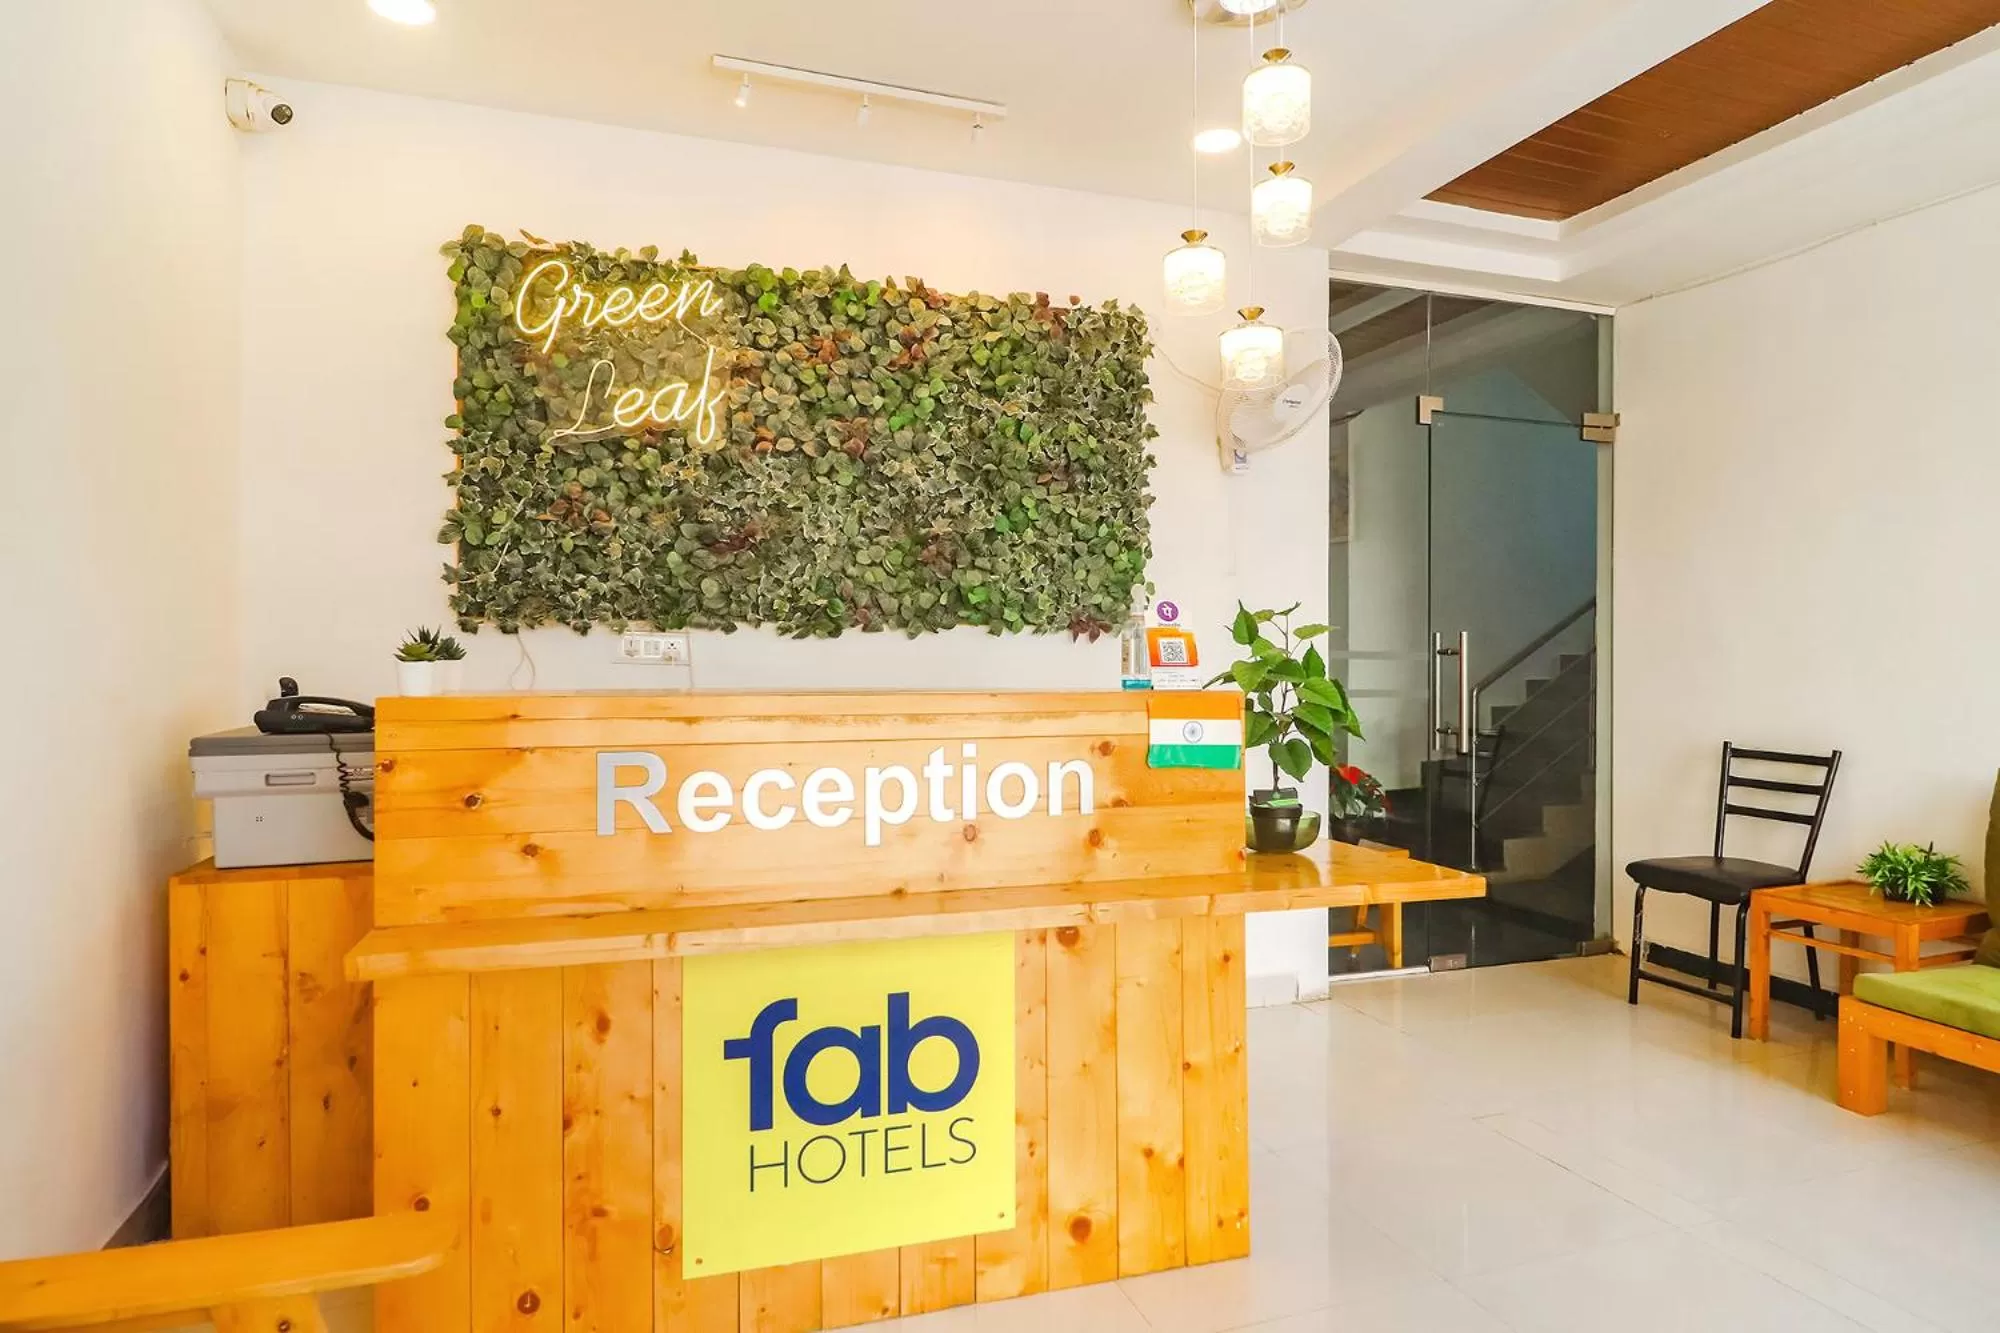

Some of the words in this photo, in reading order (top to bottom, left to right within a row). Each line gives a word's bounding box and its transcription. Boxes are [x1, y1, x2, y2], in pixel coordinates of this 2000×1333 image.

[516, 260, 724, 354] Green
[546, 346, 726, 445] Leaf
[595, 742, 1095, 847] Reception
[723, 991, 981, 1132] fab
[750, 1116, 977, 1192] HOTELS
